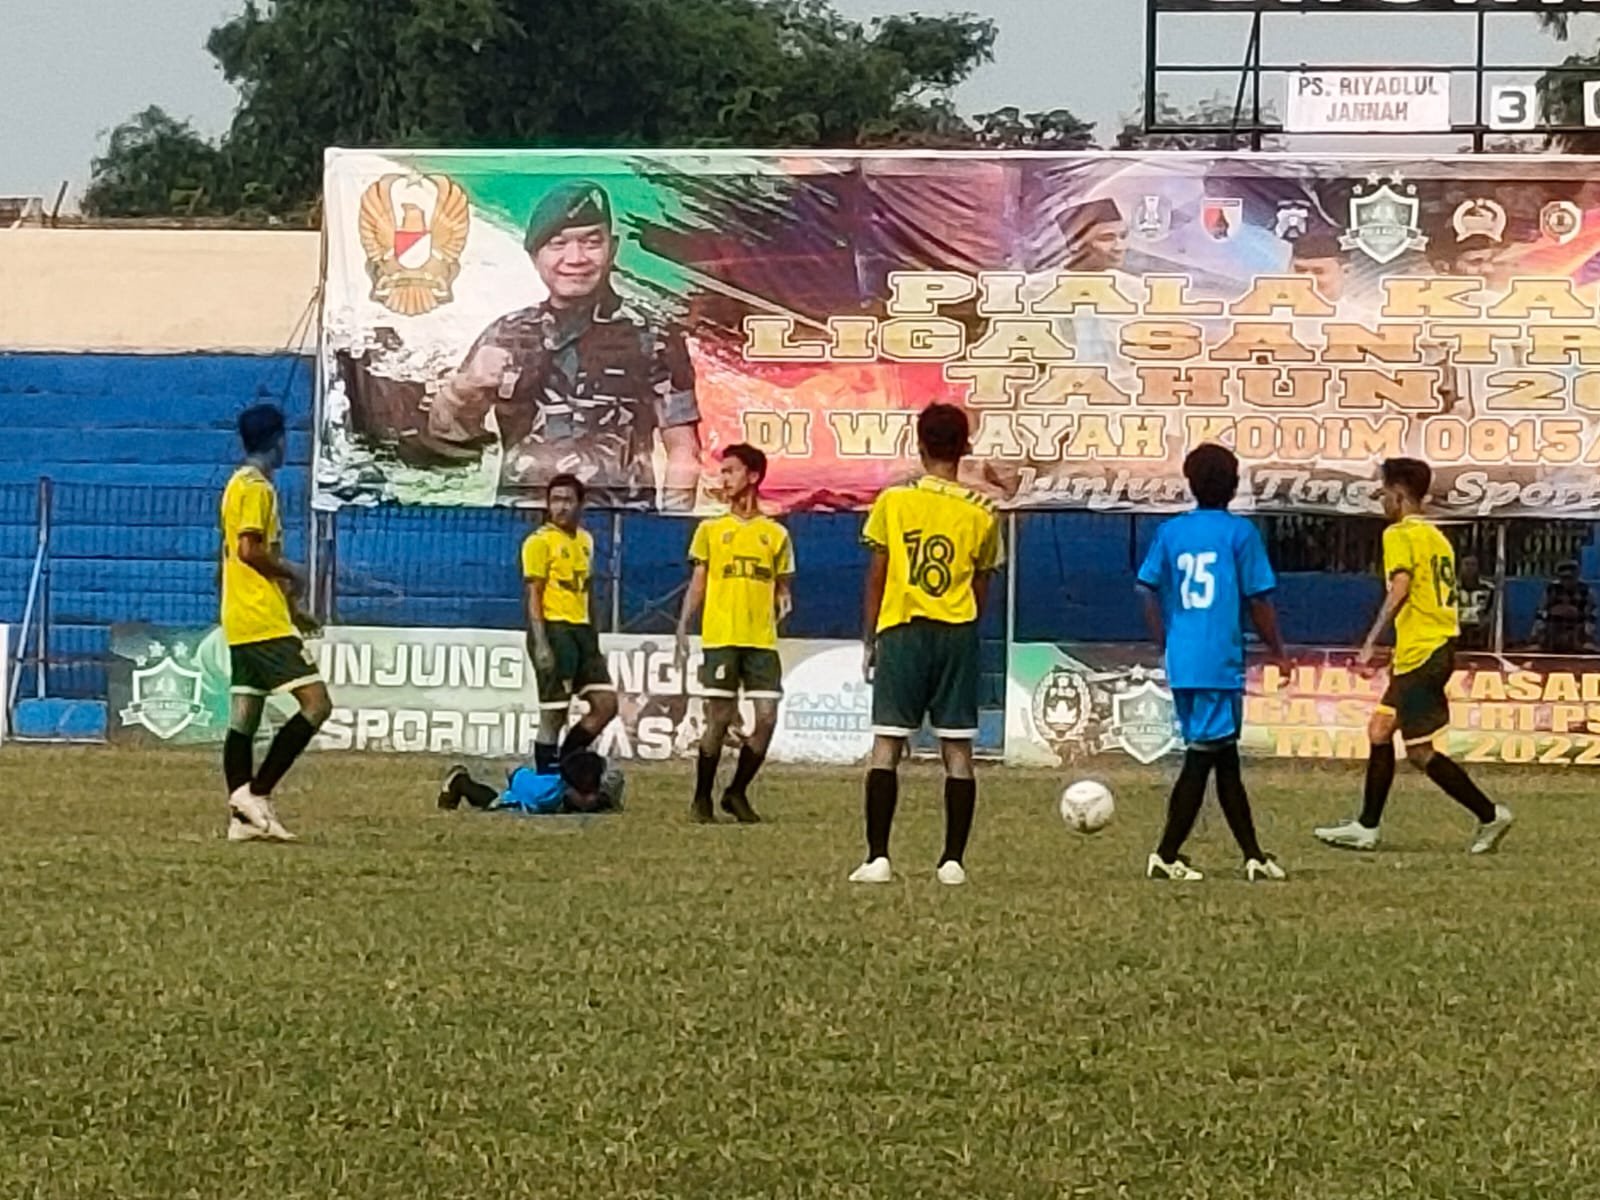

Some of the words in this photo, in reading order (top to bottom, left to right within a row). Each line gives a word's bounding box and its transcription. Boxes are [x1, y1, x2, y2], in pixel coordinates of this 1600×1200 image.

[1326, 102, 1409, 122] JANNAH
[1498, 90, 1527, 124] 3
[888, 271, 1337, 318] PIALA
[1381, 277, 1600, 320] KA
[744, 316, 1077, 361] LIGA
[944, 364, 1441, 409] TAHUN
[743, 412, 810, 456] DI
[829, 412, 1167, 459] WAYAH
[1186, 416, 1405, 462] KODIM
[904, 530, 955, 598] 18
[1177, 551, 1217, 610] 25
[1463, 734, 1600, 764] 2022
